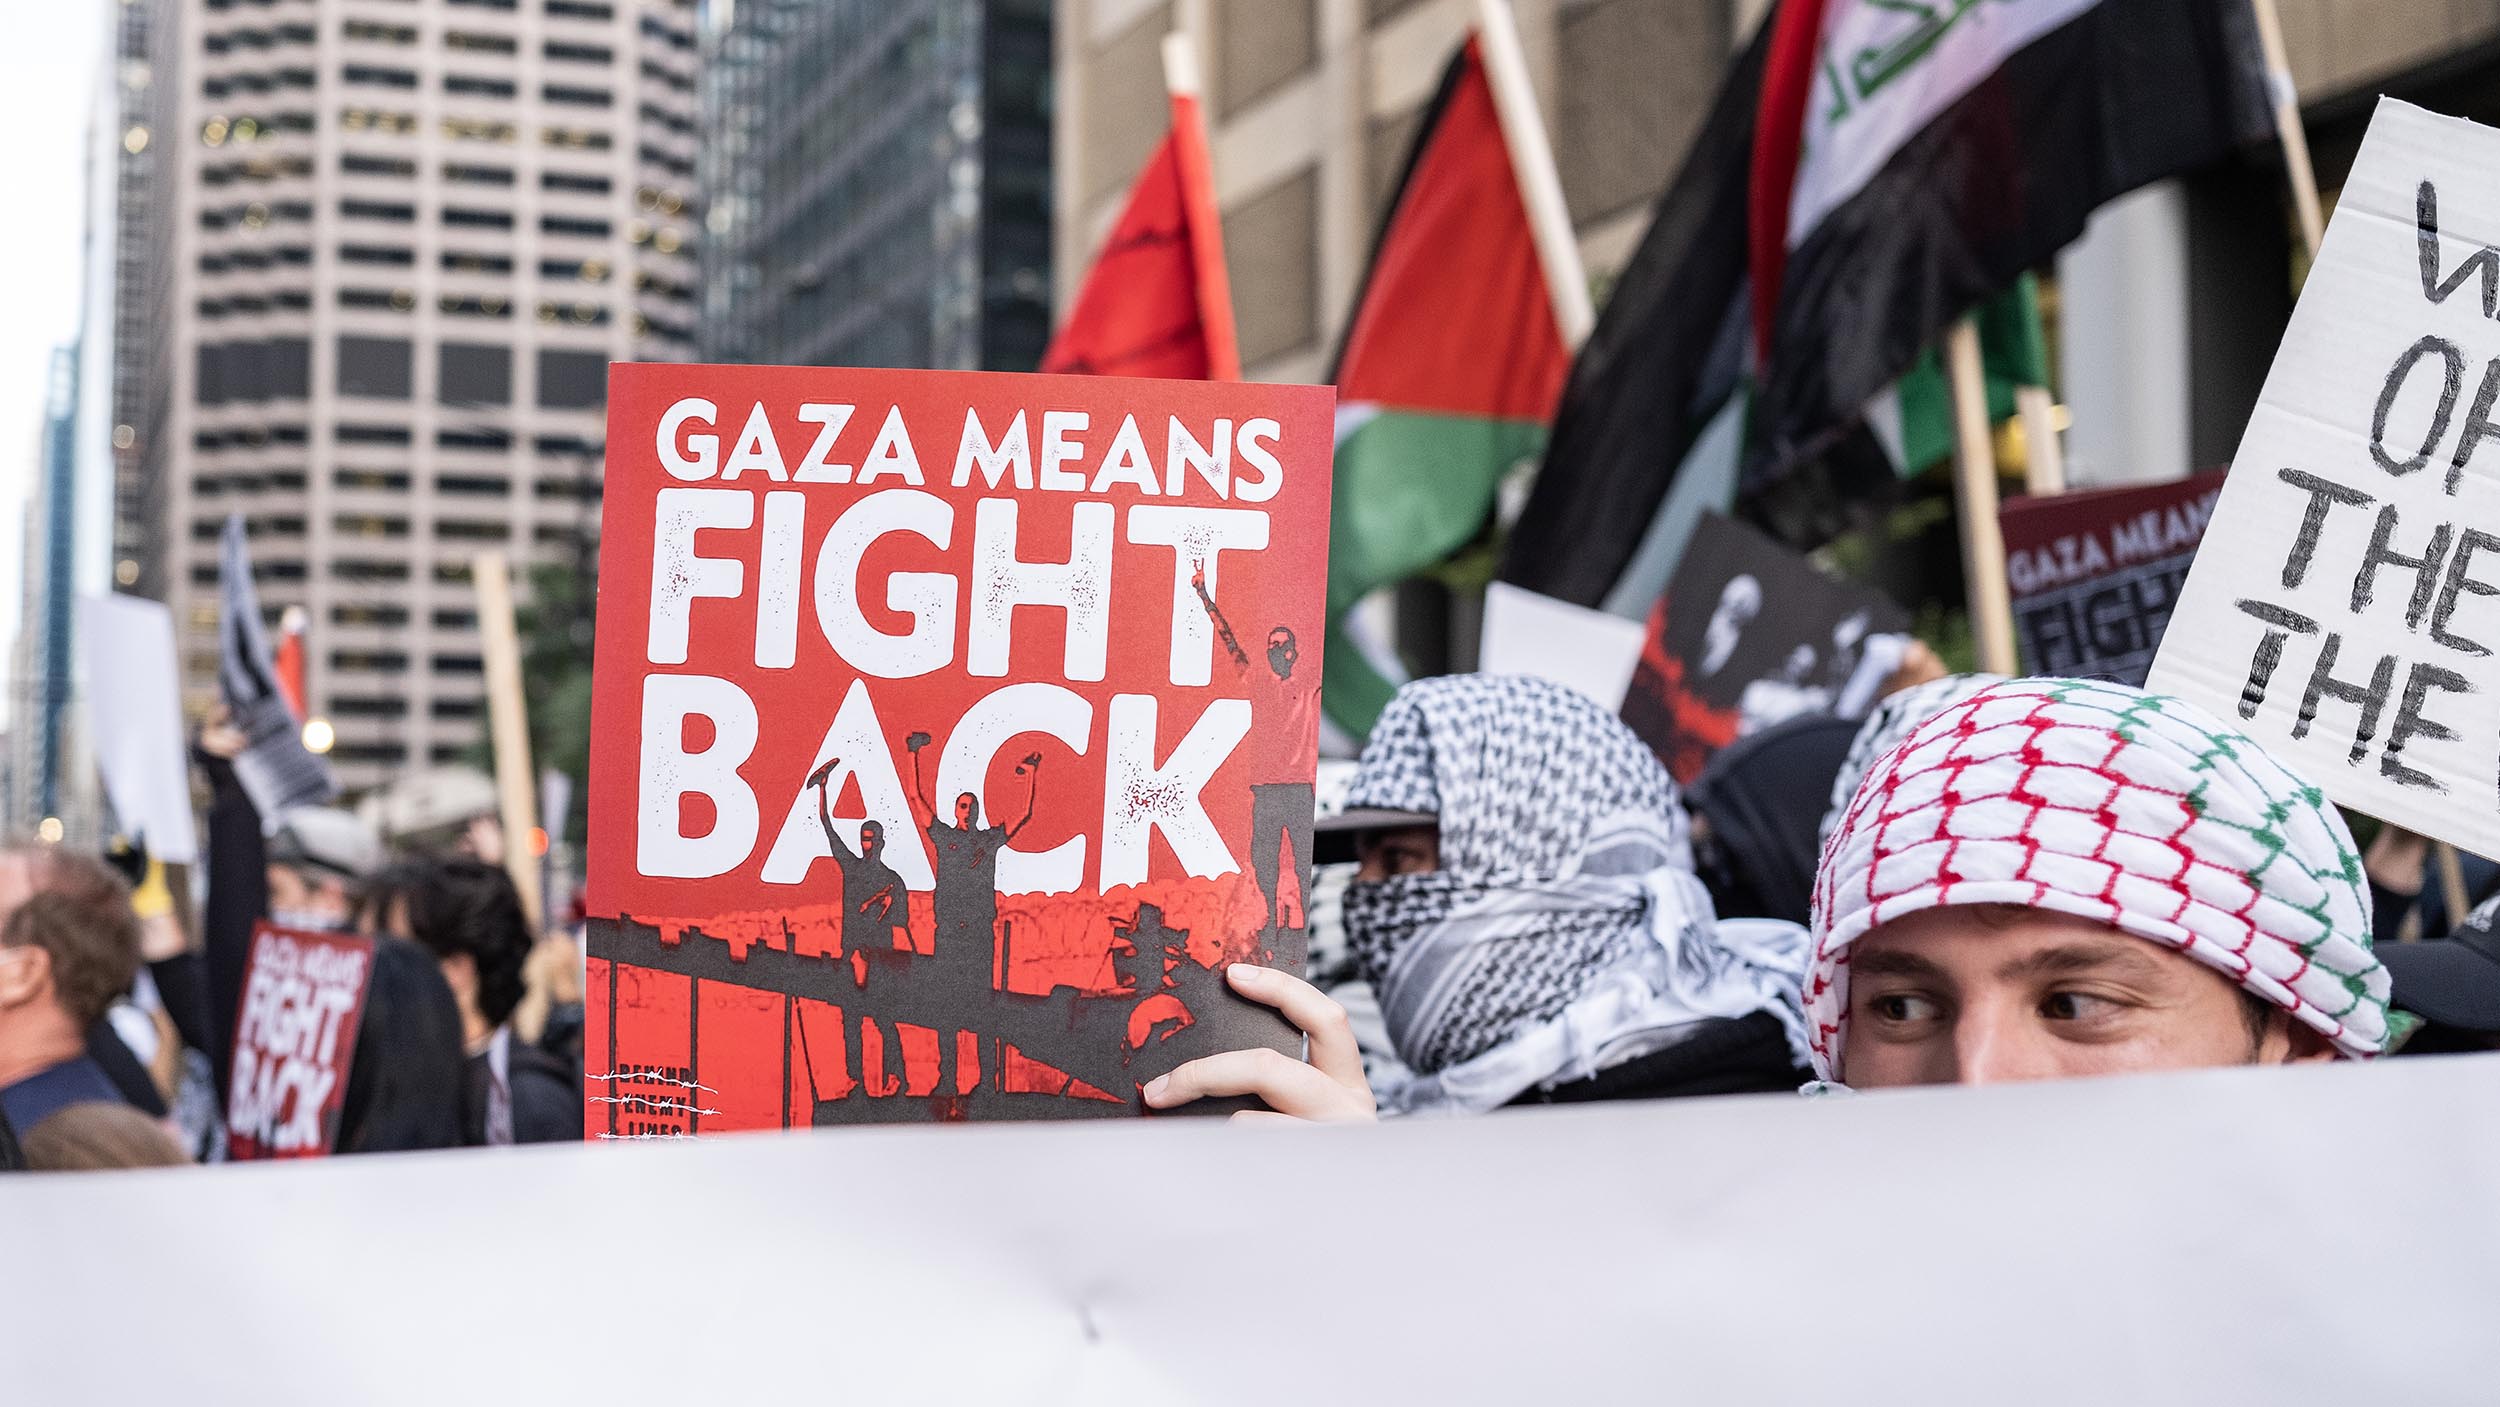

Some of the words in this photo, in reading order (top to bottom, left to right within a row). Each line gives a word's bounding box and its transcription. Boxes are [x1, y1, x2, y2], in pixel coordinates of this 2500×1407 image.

[656, 398, 925, 485] GAZA
[951, 407, 1283, 502] MEANS
[648, 488, 1270, 687] FIGHT
[2008, 533, 2109, 593] GAZA
[2111, 489, 2219, 565] MEAN
[2277, 467, 2500, 657] THE
[2025, 565, 2193, 674] FIGH
[2235, 597, 2474, 795] THE
[637, 674, 1252, 898] BACK
[619, 1063, 693, 1088] BEHIND
[624, 1093, 687, 1117] ENEMY
